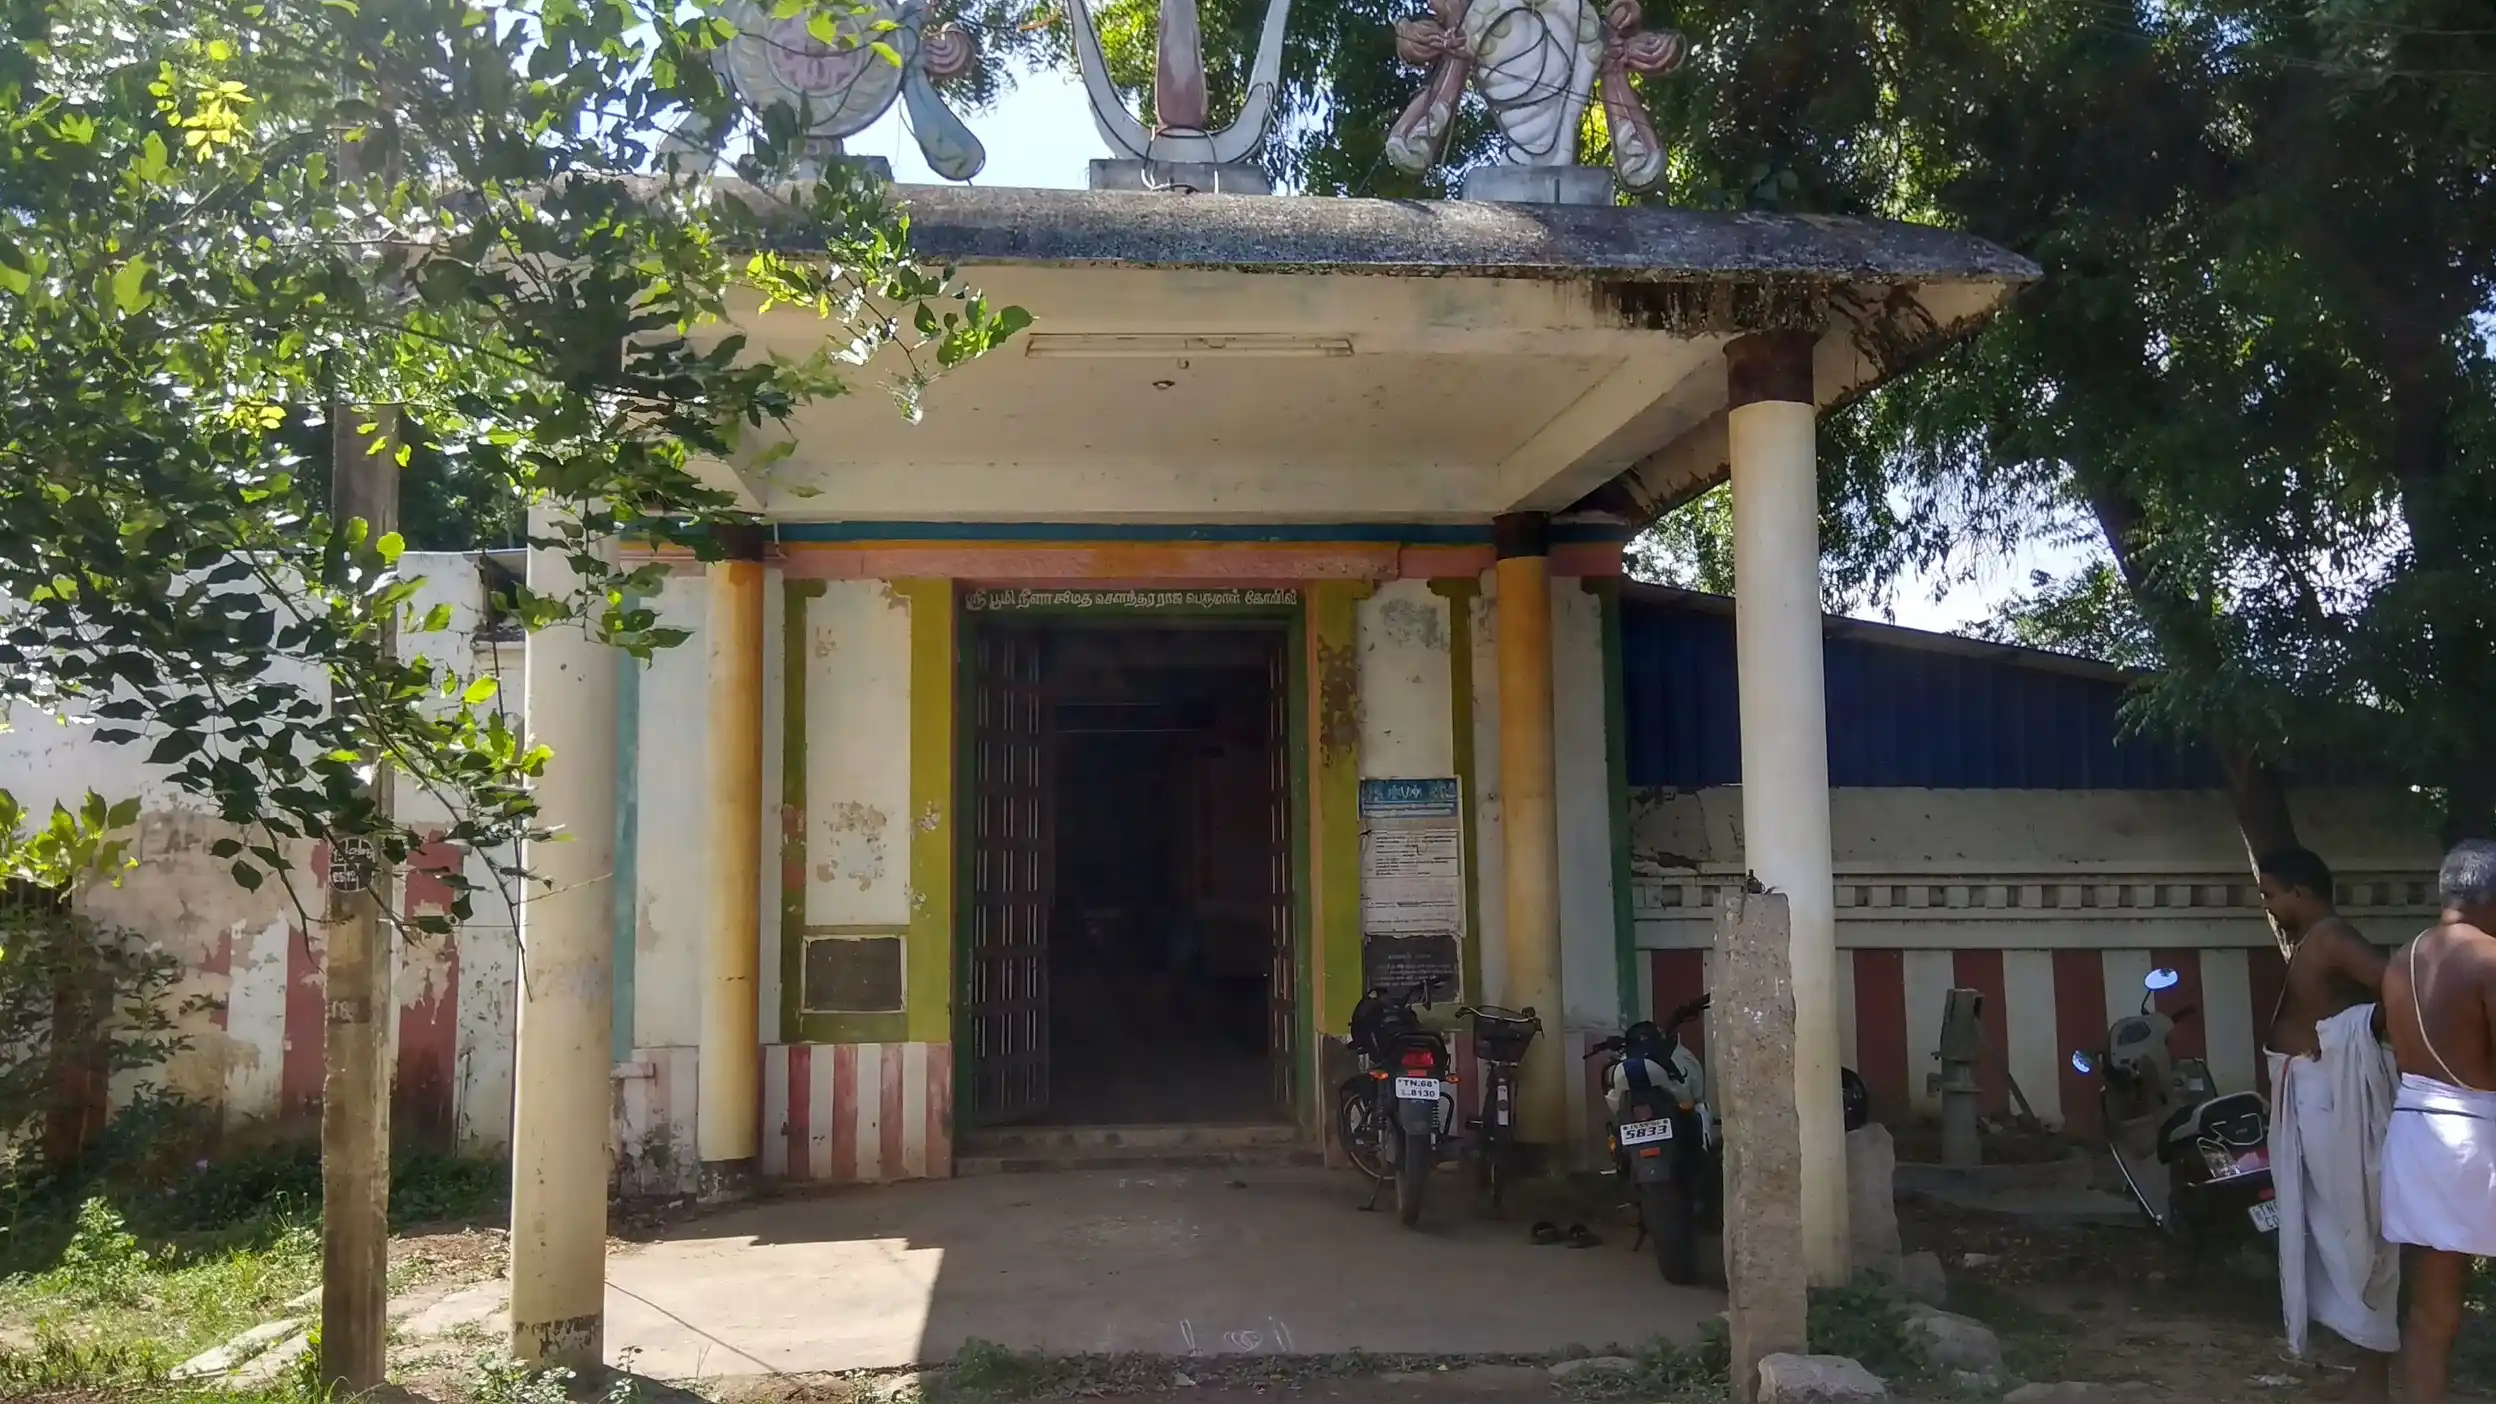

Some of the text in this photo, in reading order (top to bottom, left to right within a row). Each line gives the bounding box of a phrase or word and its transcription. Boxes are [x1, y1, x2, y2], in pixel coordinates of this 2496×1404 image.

[989, 589, 1016, 610] பூமி
[1186, 588, 1241, 609] பெருமாள்
[1245, 588, 1298, 605] கோவில்
[1625, 1125, 1667, 1140] 5833
